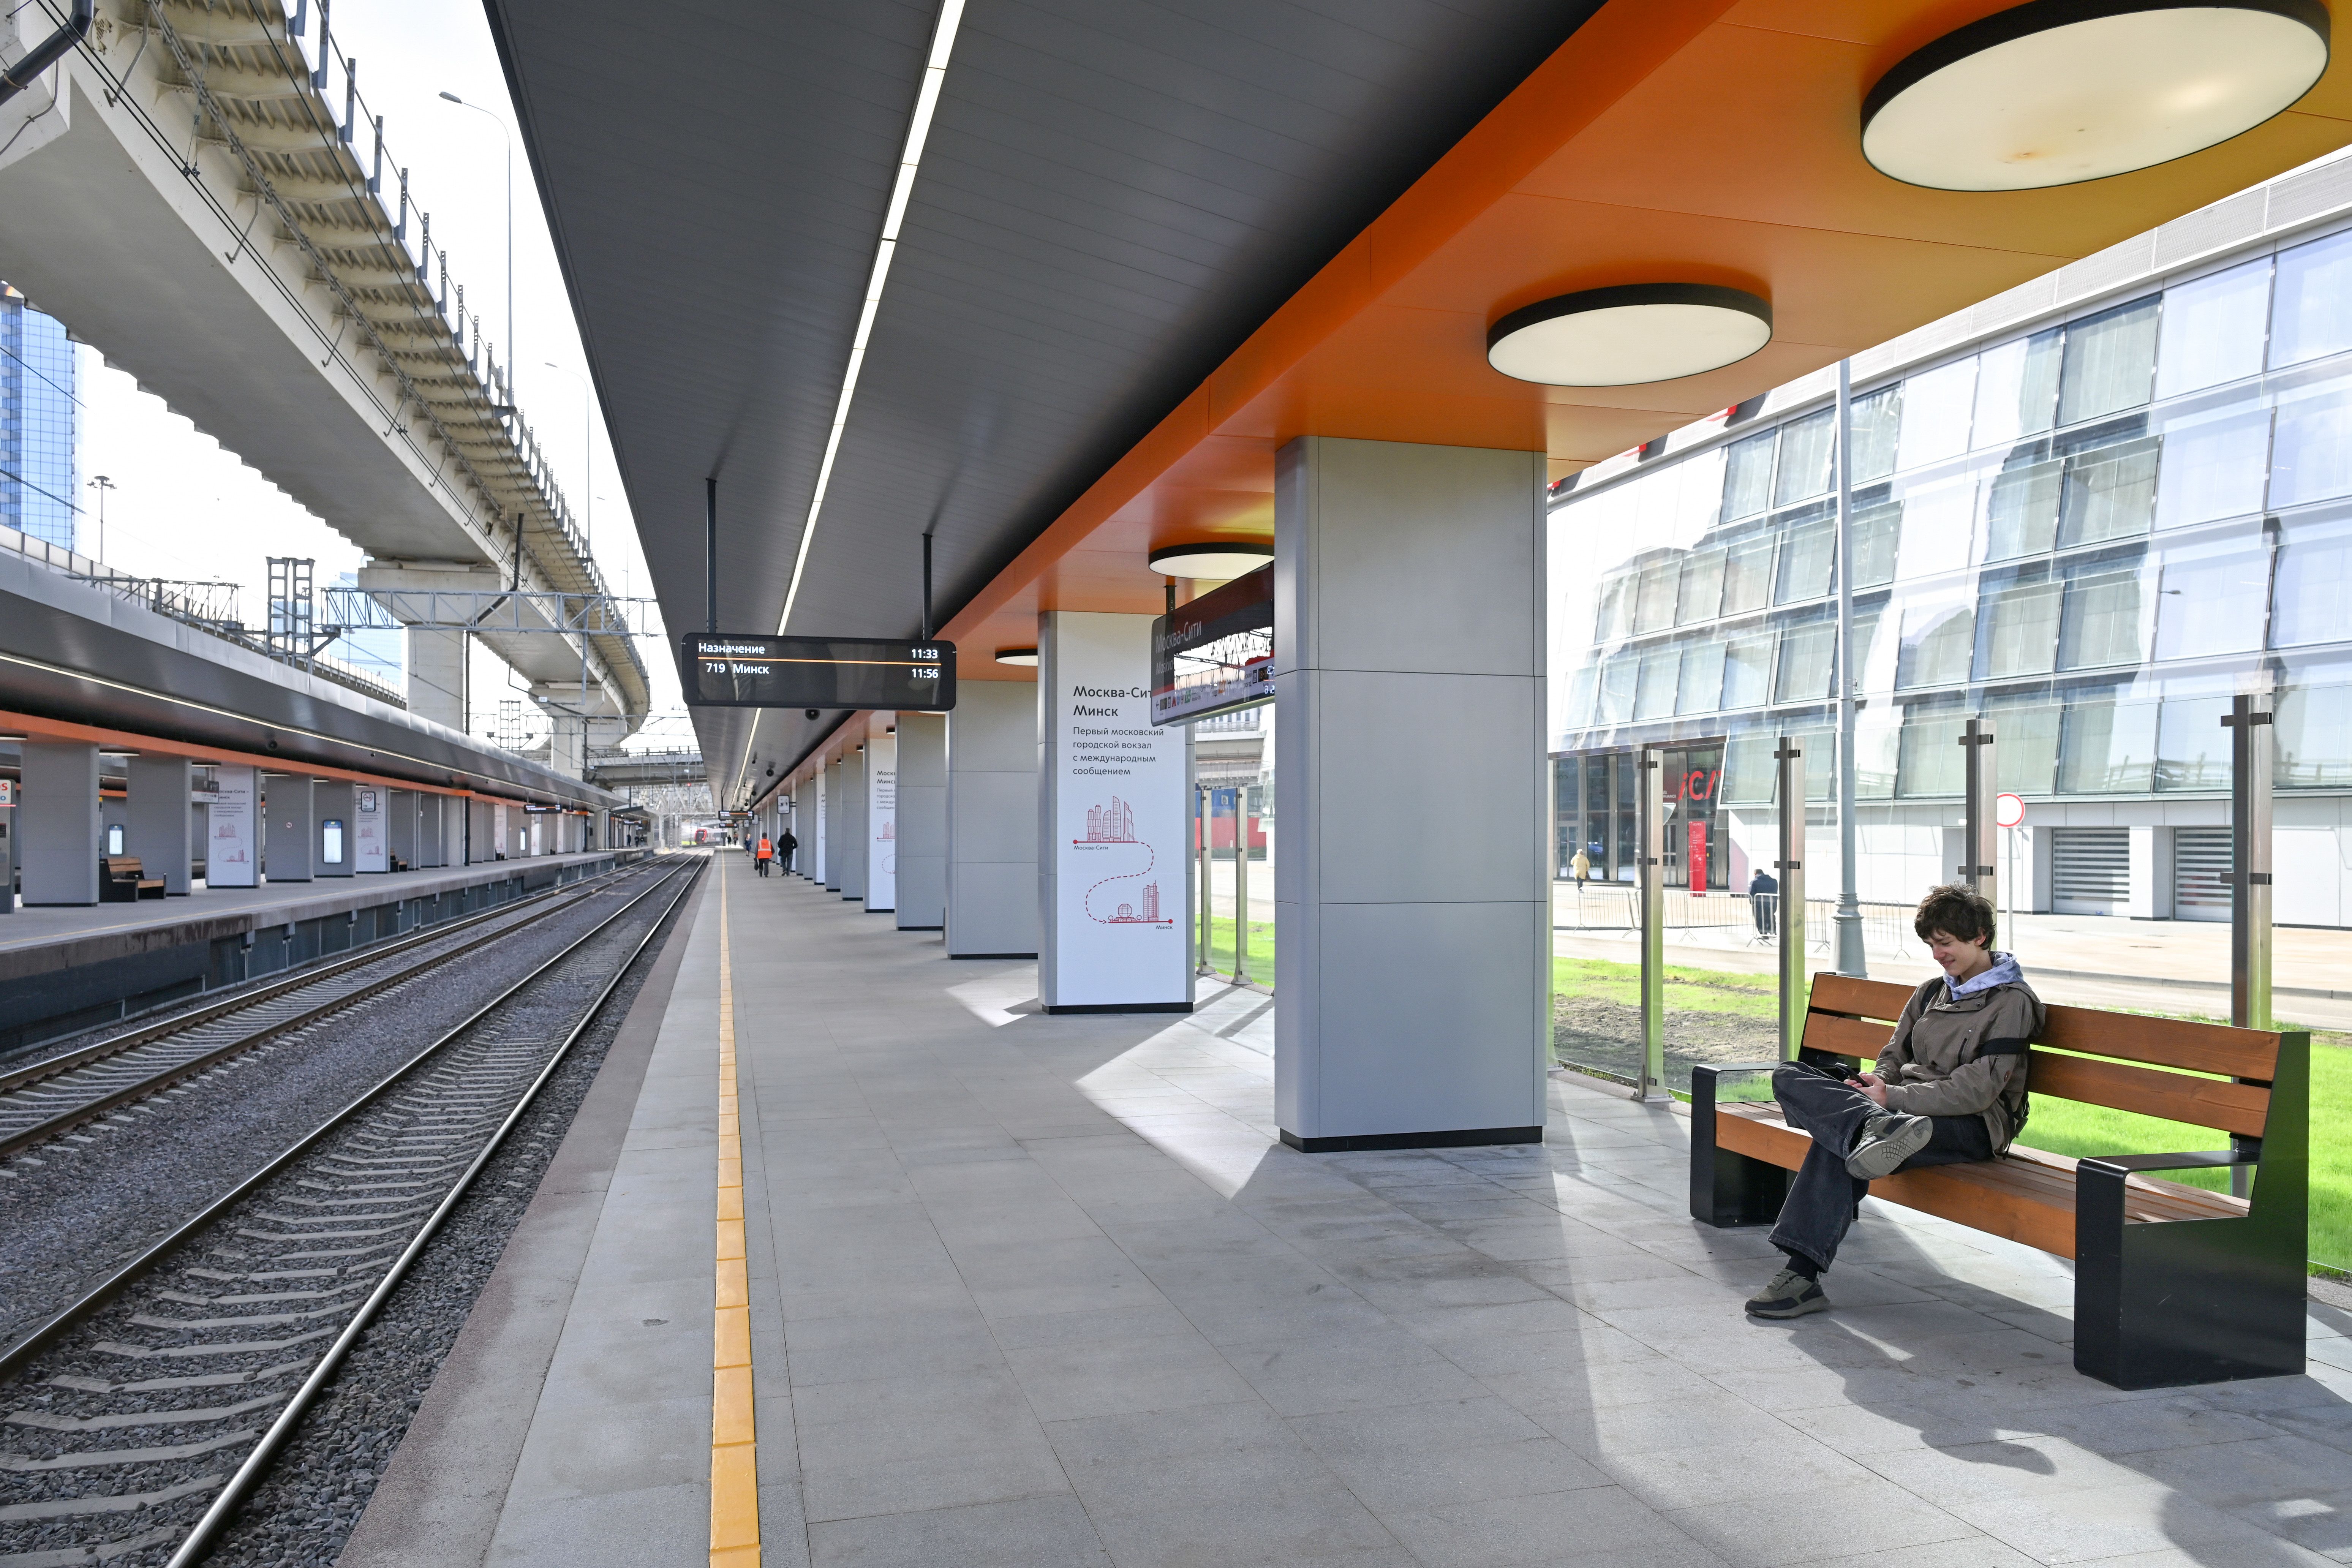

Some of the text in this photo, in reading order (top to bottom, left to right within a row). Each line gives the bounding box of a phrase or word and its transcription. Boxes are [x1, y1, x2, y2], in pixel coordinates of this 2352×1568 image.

[1156, 621, 1201, 654] Москва-Сити
[699, 642, 938, 659] Назначение 11:33
[706, 663, 939, 678] 719 Минск 11:56
[1073, 686, 1151, 698] Москва-Сит
[1073, 705, 1119, 716] Минск
[1073, 727, 1108, 737] Первый
[1073, 741, 1119, 749] городской
[1073, 767, 1130, 776] сообщением
